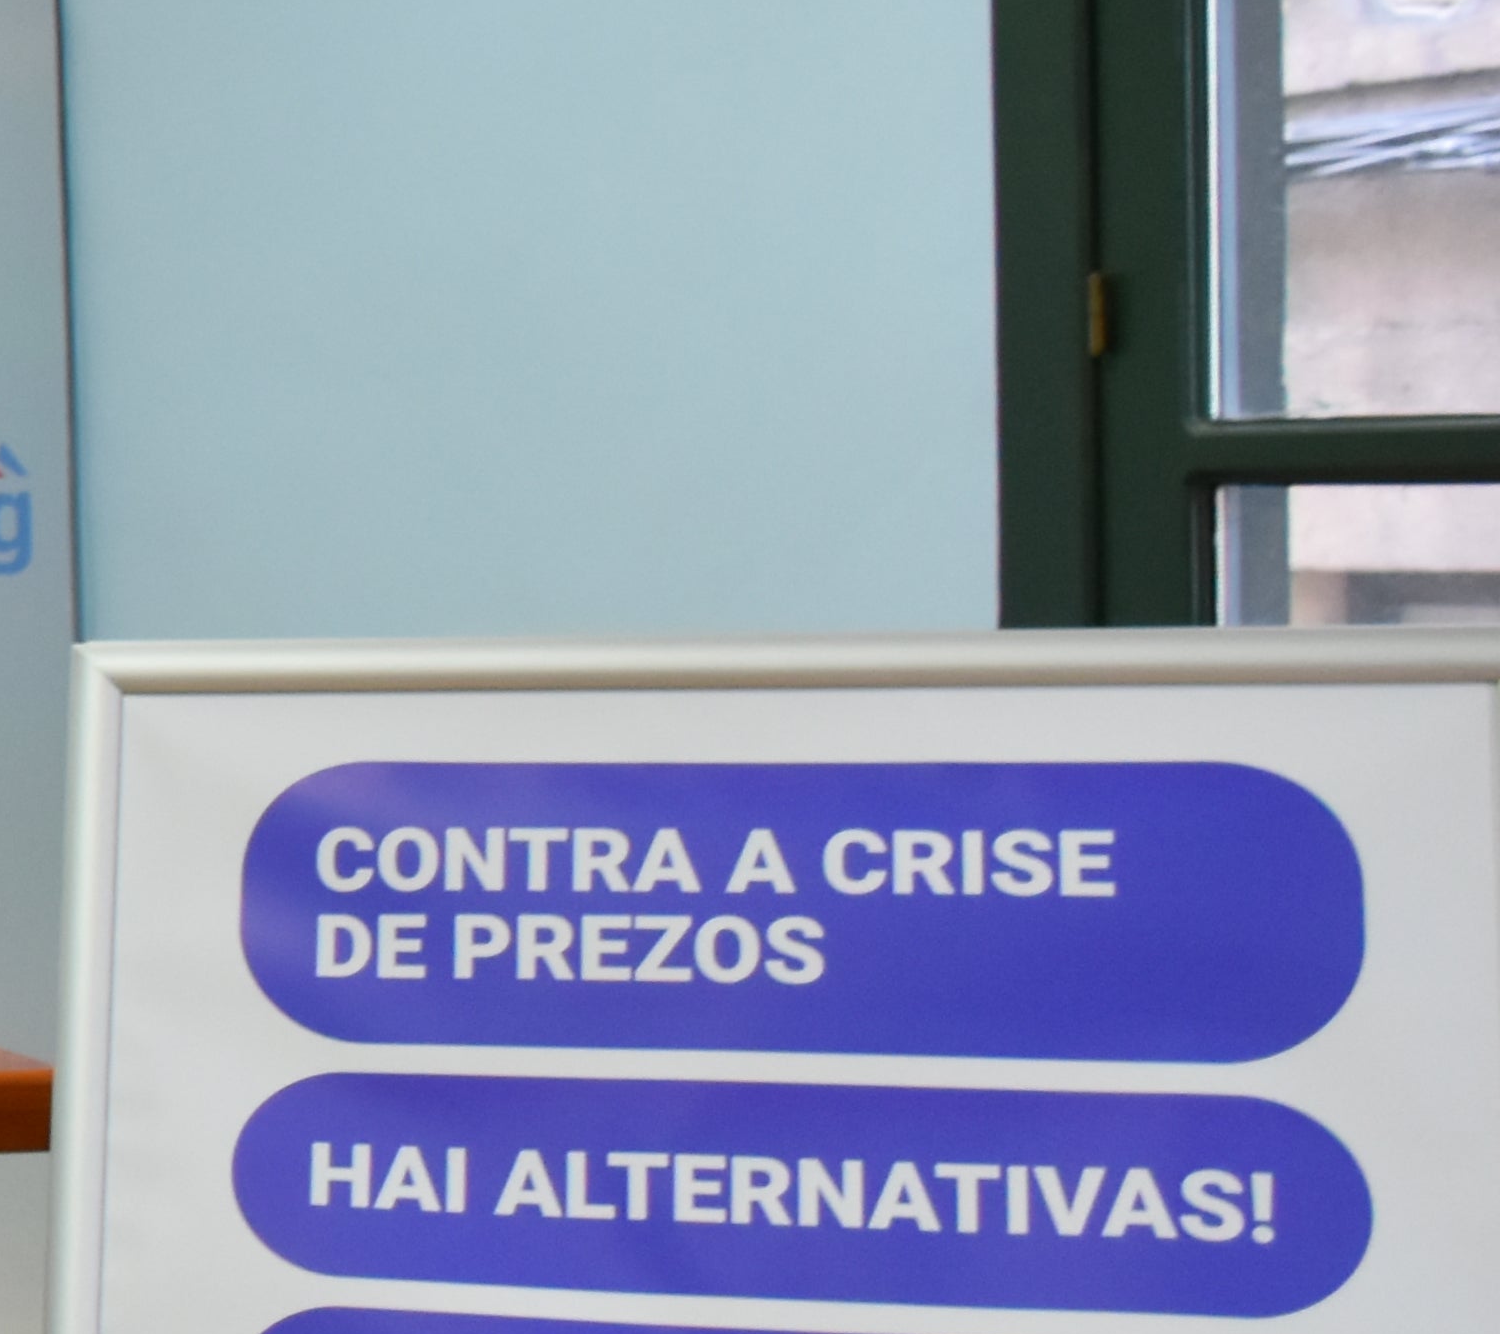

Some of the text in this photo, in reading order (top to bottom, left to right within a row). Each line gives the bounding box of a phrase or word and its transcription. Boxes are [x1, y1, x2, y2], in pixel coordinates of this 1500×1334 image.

[316, 825, 1117, 898] CONTRA A CRISE
[316, 914, 826, 985] DE PREZOS
[309, 1142, 1277, 1244] HAI ALTERNATIVAS!
